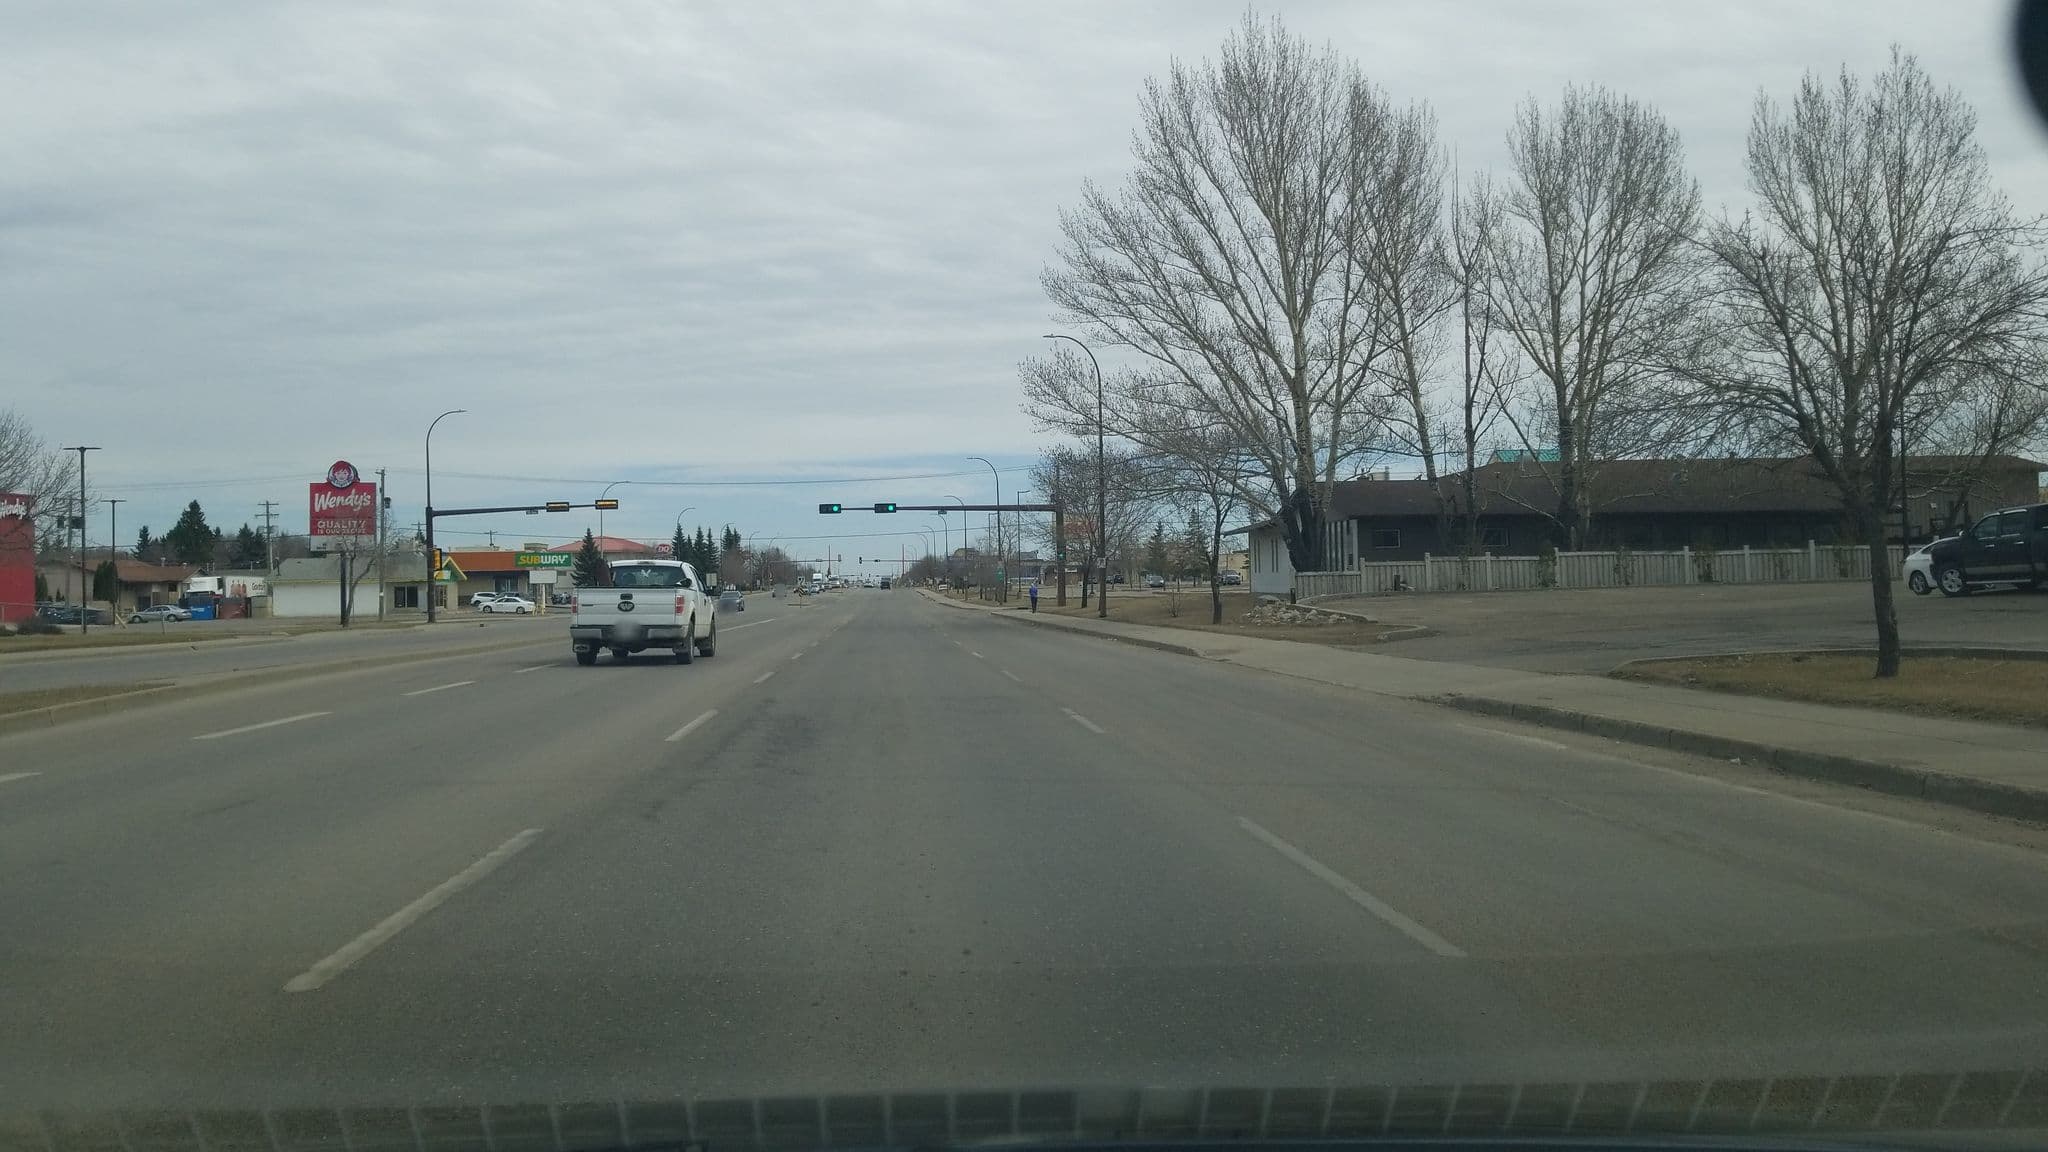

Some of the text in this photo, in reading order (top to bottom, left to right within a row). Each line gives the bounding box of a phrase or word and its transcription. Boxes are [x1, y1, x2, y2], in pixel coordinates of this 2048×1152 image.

[314, 489, 371, 512] Wendy's
[317, 520, 367, 529] QUALITY
[657, 545, 670, 553] DQ
[518, 554, 568, 564] SUBWAY
